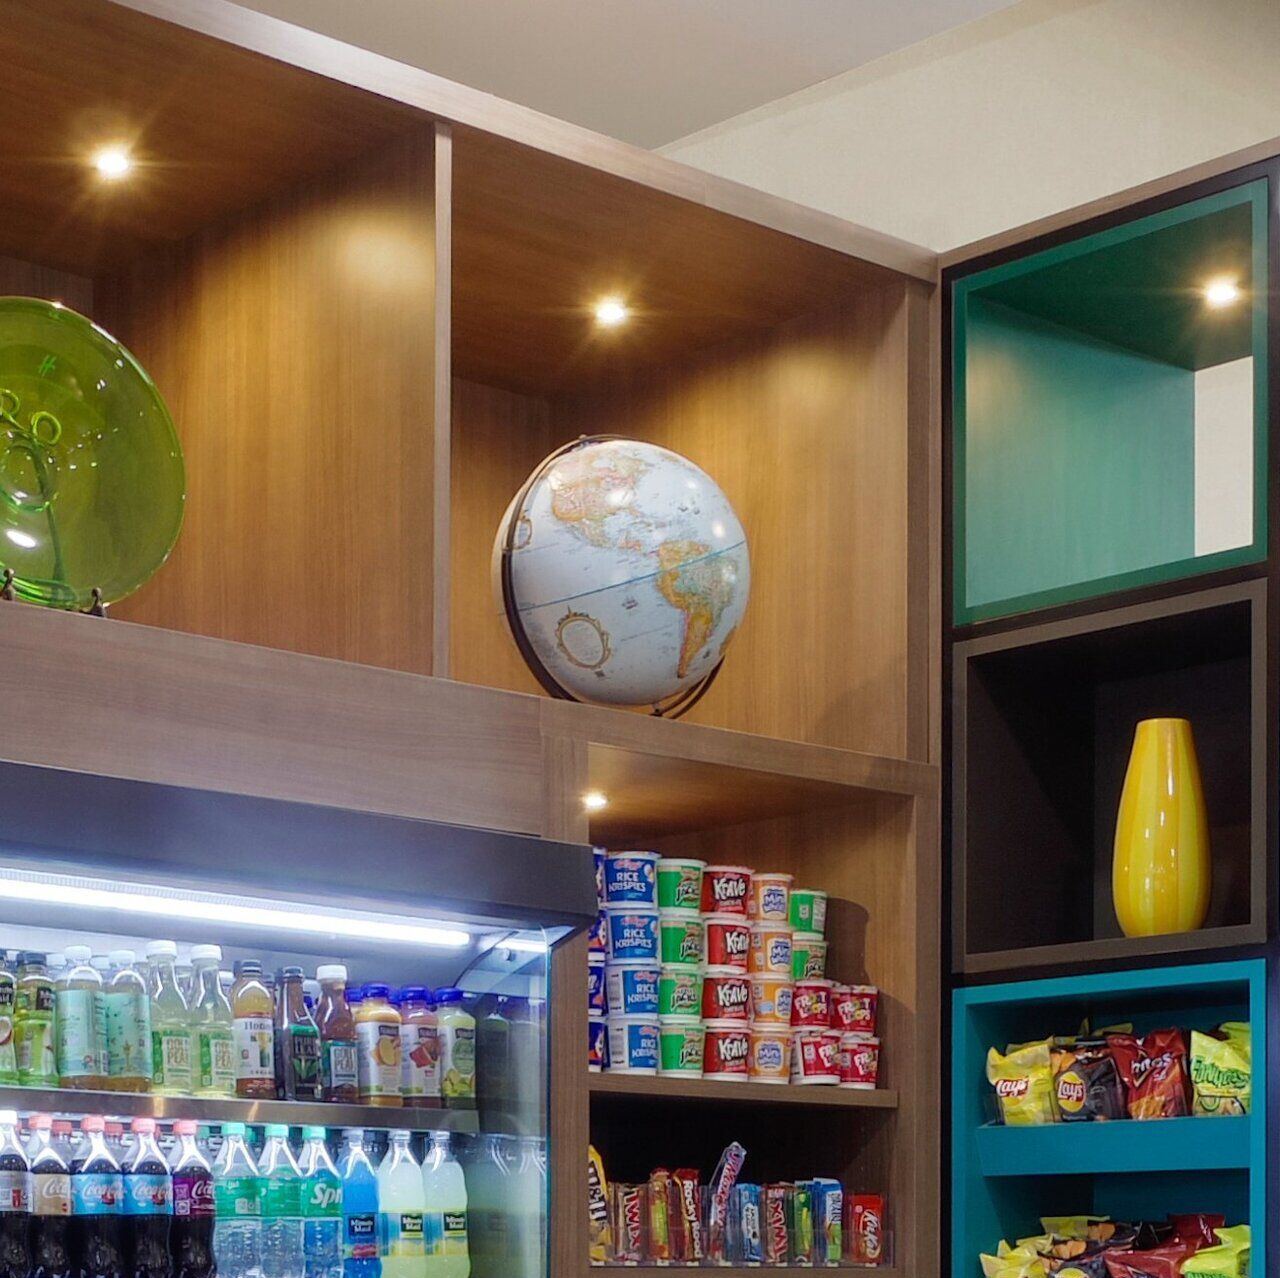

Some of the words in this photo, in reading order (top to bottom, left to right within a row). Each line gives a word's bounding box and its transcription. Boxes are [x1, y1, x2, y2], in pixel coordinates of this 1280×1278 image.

[616, 872, 638, 880] RICE
[609, 882, 646, 892] KRISPIES
[624, 929, 645, 937] RICE
[615, 937, 652, 948] KRISPIES
[637, 984, 655, 992] RICE
